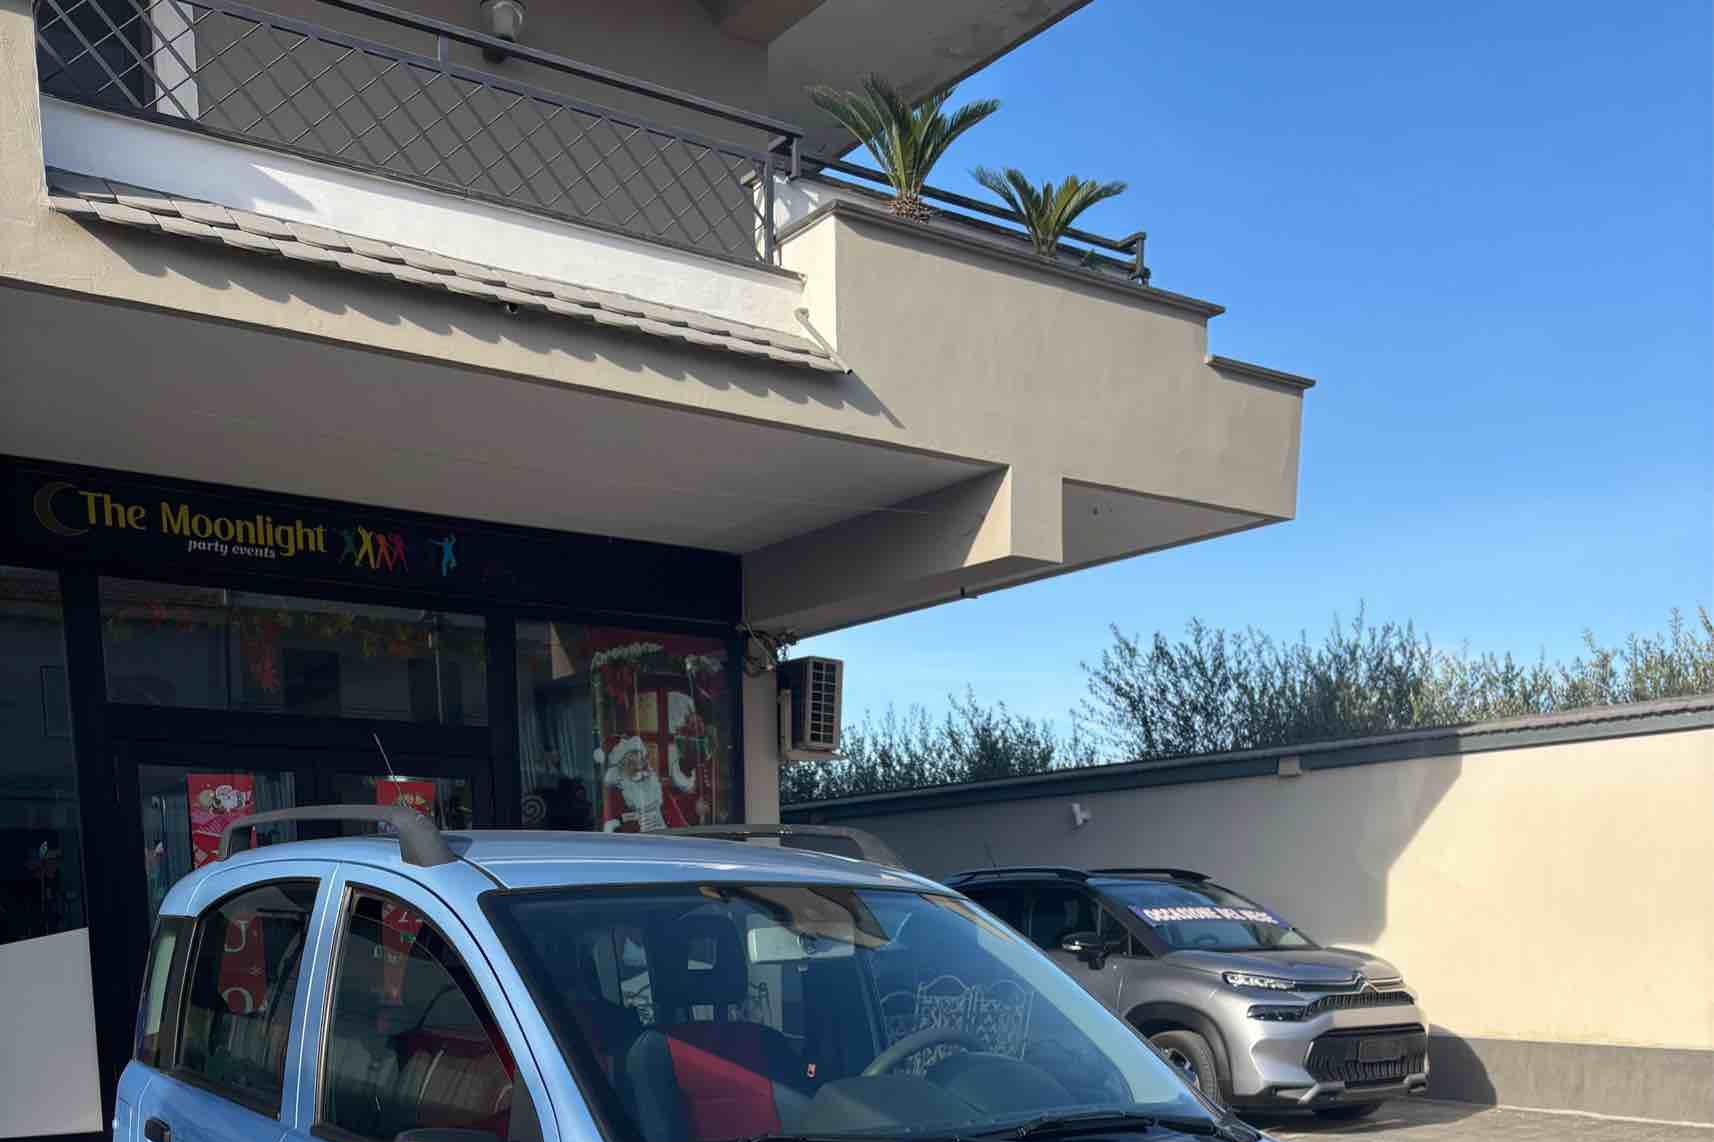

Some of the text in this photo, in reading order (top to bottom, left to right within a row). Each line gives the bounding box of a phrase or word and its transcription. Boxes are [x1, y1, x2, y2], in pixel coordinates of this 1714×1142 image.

[80, 490, 328, 557] The Moonlight
[187, 538, 277, 560] party events
